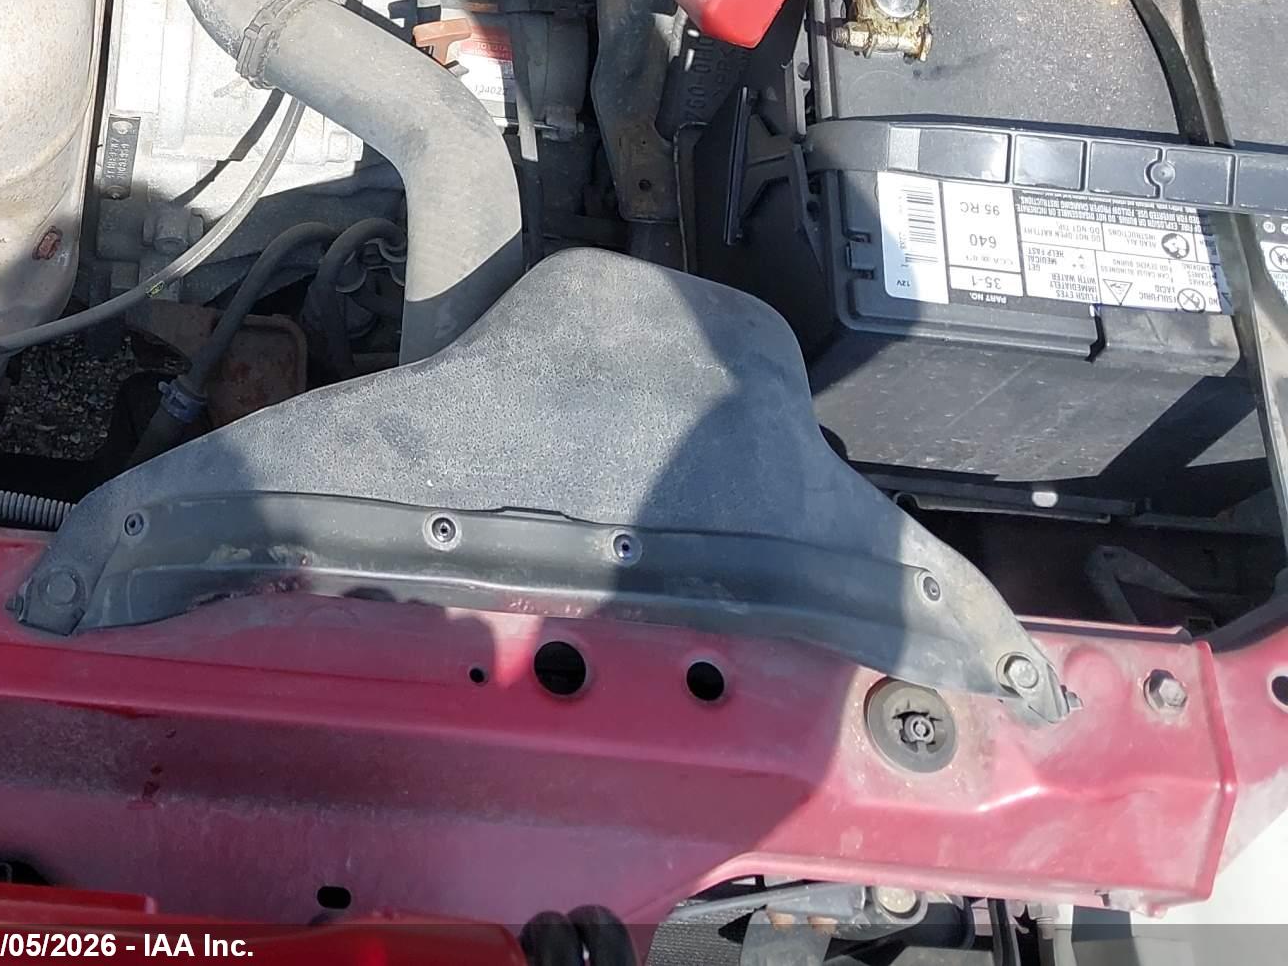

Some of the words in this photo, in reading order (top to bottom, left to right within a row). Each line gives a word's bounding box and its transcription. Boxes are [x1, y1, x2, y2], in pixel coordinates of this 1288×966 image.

[959, 201, 979, 214] RC
[985, 204, 1000, 216] 95
[969, 234, 997, 249] 640
[1028, 247, 1044, 255] FAST
[1047, 249, 1064, 258] HELP
[1027, 255, 1057, 265] MEDICAL
[1028, 264, 1041, 272] GET
[971, 275, 1002, 290] 35-1
[1051, 273, 1076, 283] WATER
[1077, 275, 1096, 285] WITH
[1050, 281, 1097, 293] IMMEDIATELY
[969, 292, 984, 302] NO.
[984, 294, 1006, 304] PART
[1055, 290, 1074, 299] EYES
[1075, 292, 1098, 302] FLUSH
